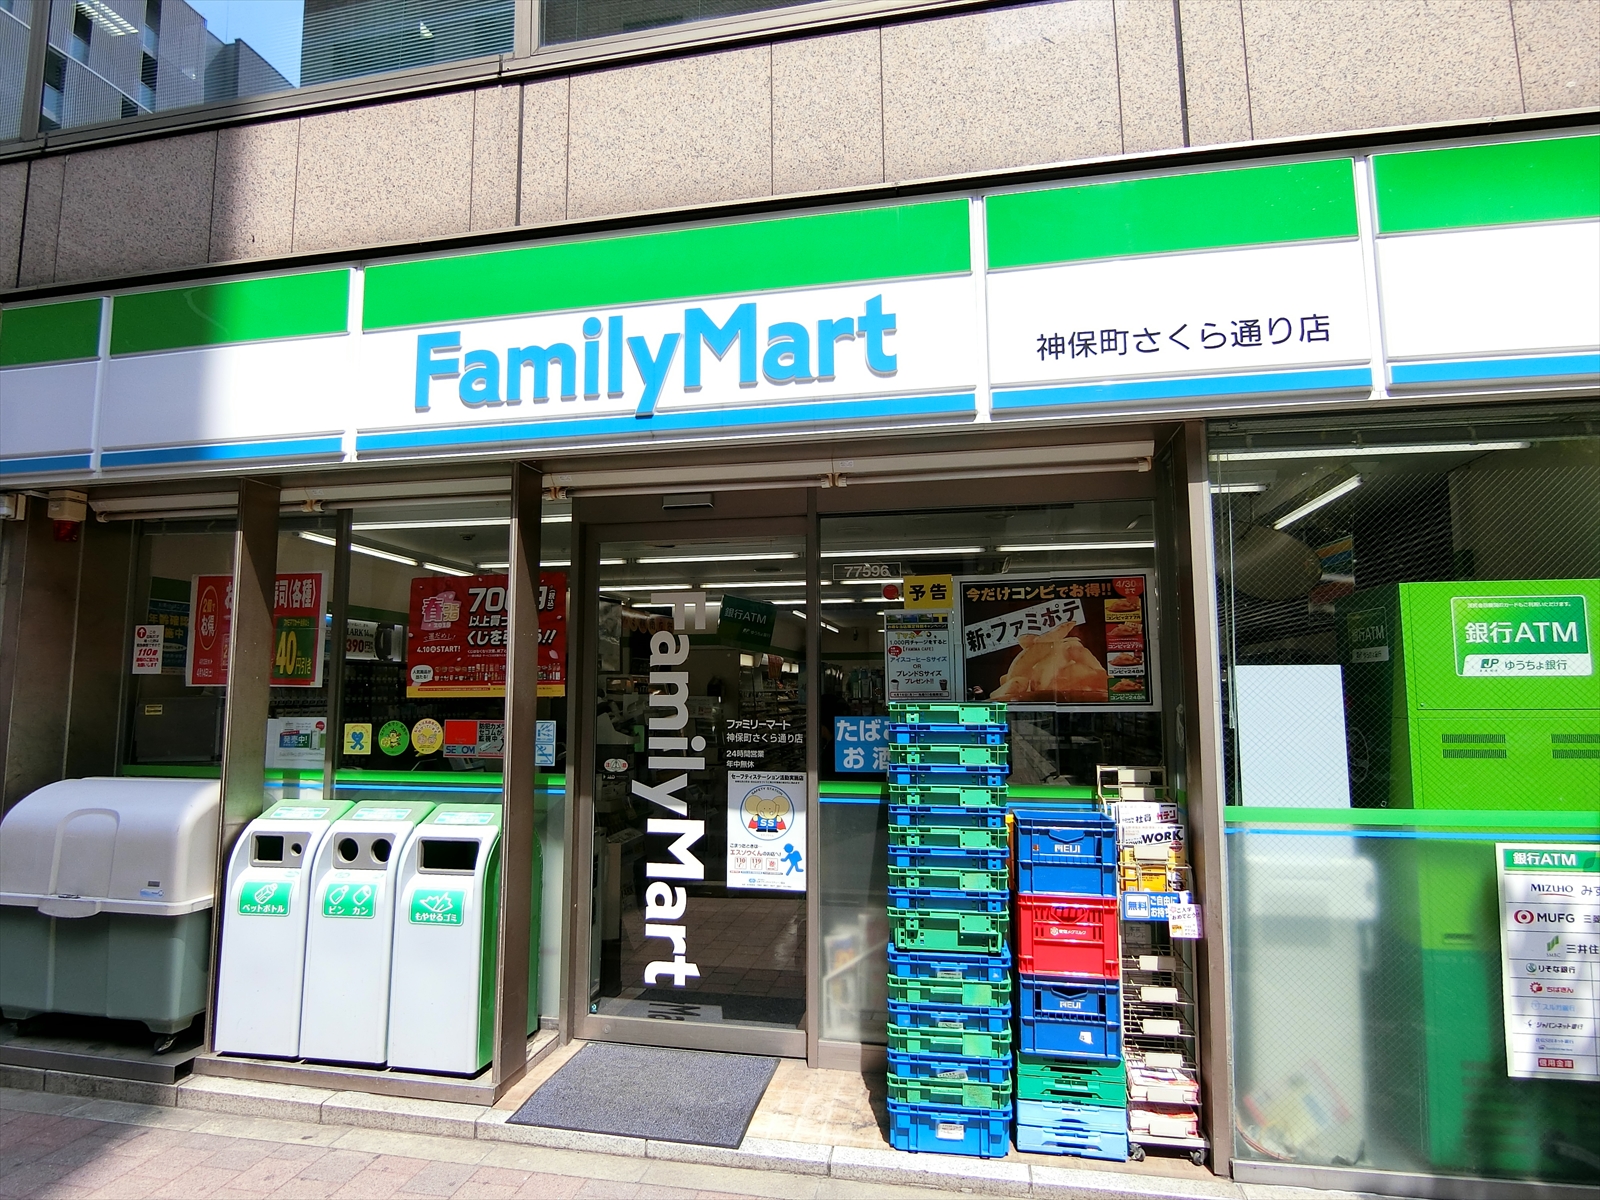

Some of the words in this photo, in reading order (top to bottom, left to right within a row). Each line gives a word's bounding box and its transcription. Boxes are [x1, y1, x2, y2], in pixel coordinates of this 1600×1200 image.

[1036, 313, 1330, 361] 神保町さくら通り店
[415, 294, 897, 418] FamilyMart
[844, 565, 890, 578] 77596
[1115, 580, 1137, 588] 4/30
[909, 583, 947, 601] 予告
[966, 582, 1112, 602] 今だけコンビでお得!!
[724, 607, 767, 625] 銀行ATM
[200, 615, 215, 637] お得
[1464, 621, 1578, 644] 銀行ATM
[1505, 659, 1568, 671] ゆうちょ銀行
[726, 719, 791, 730] ファミリーマート
[837, 719, 889, 741] たば
[726, 732, 803, 744] 神保町さくら通り店
[446, 746, 475, 754] SECOM
[726, 750, 765, 758] 24時間営業
[726, 760, 755, 768] 年中無休
[631, 592, 707, 988] FamilyMart
[1141, 829, 1184, 844] WORK
[1054, 844, 1081, 853] MEIJI
[1513, 852, 1577, 866] 銀行ATM
[1530, 883, 1574, 893] MIZUHO
[242, 904, 285, 914] ペットボトル
[328, 905, 345, 914] ビン
[352, 906, 369, 915] カン
[1128, 901, 1147, 911] 無料
[414, 912, 458, 922] もやせるゴミ
[1537, 913, 1575, 923] MUFG
[1538, 966, 1576, 974] りそな銀行
